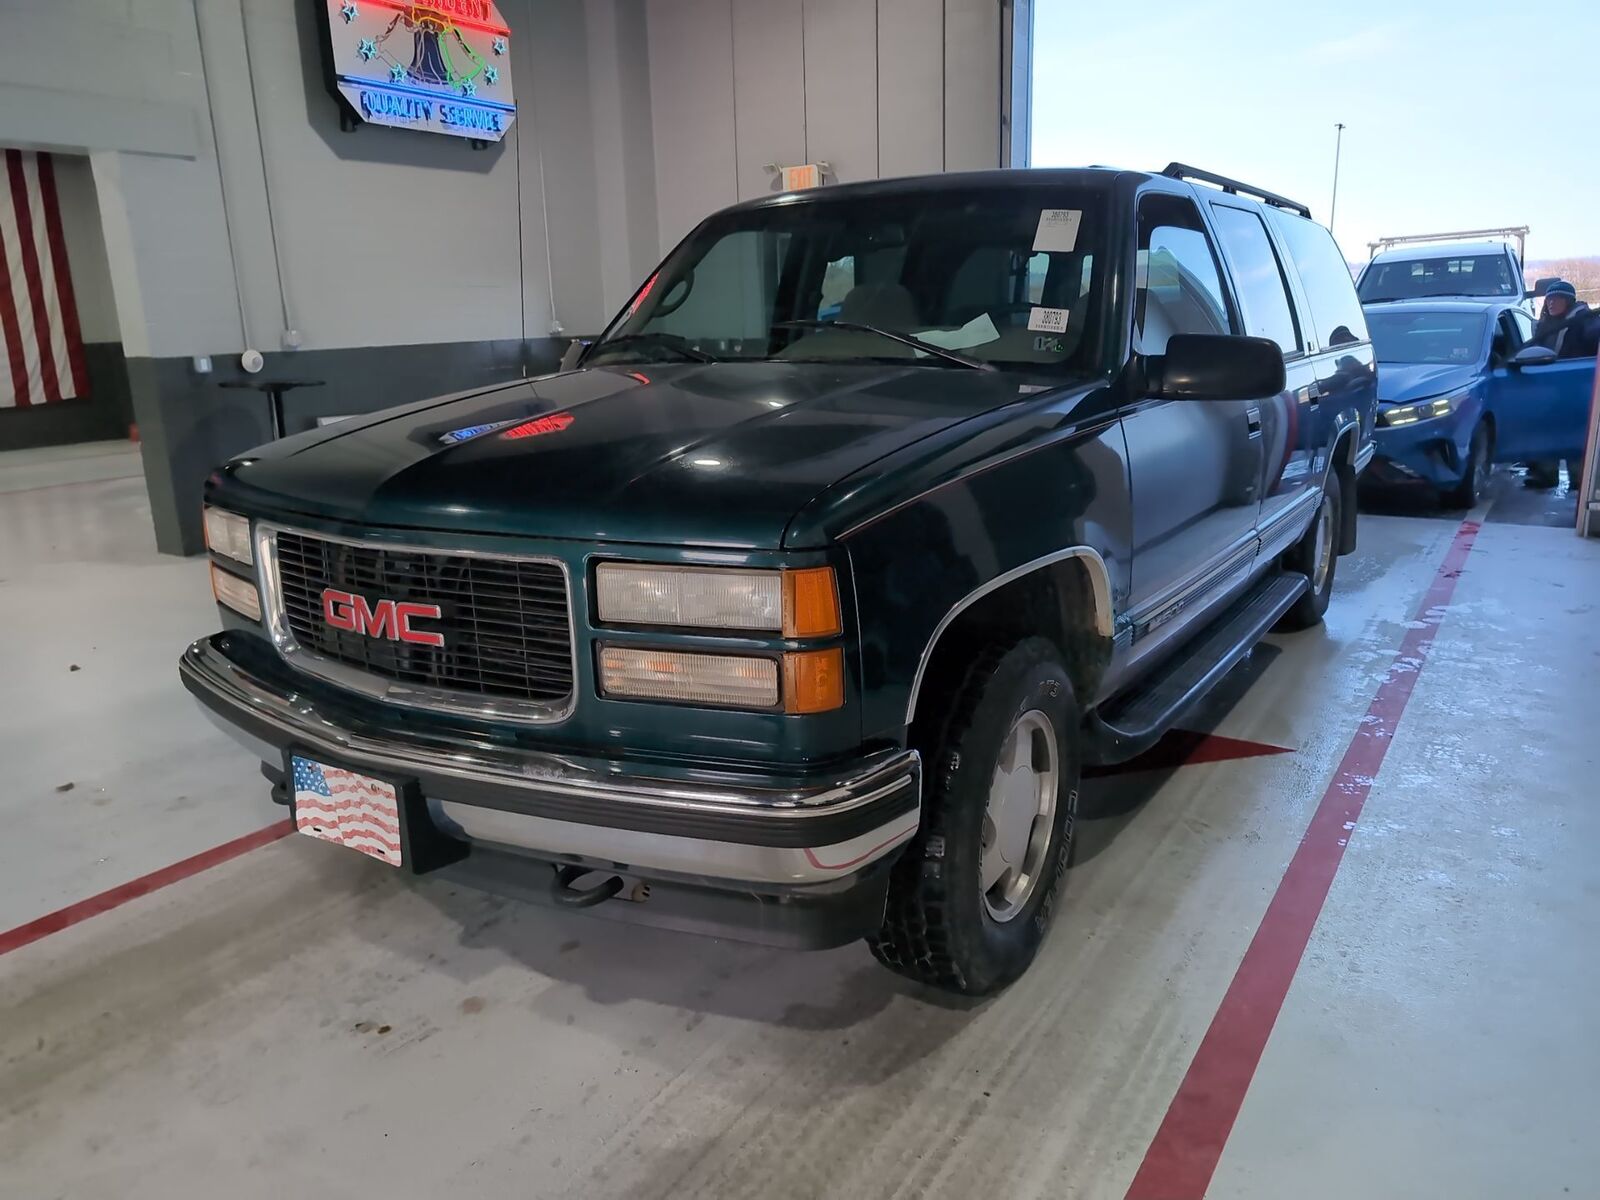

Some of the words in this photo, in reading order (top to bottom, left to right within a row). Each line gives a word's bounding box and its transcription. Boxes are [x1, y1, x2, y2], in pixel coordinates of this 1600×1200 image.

[361, 91, 433, 122] QUALITY
[440, 105, 502, 132] SERVICE
[322, 588, 444, 647] GMC
